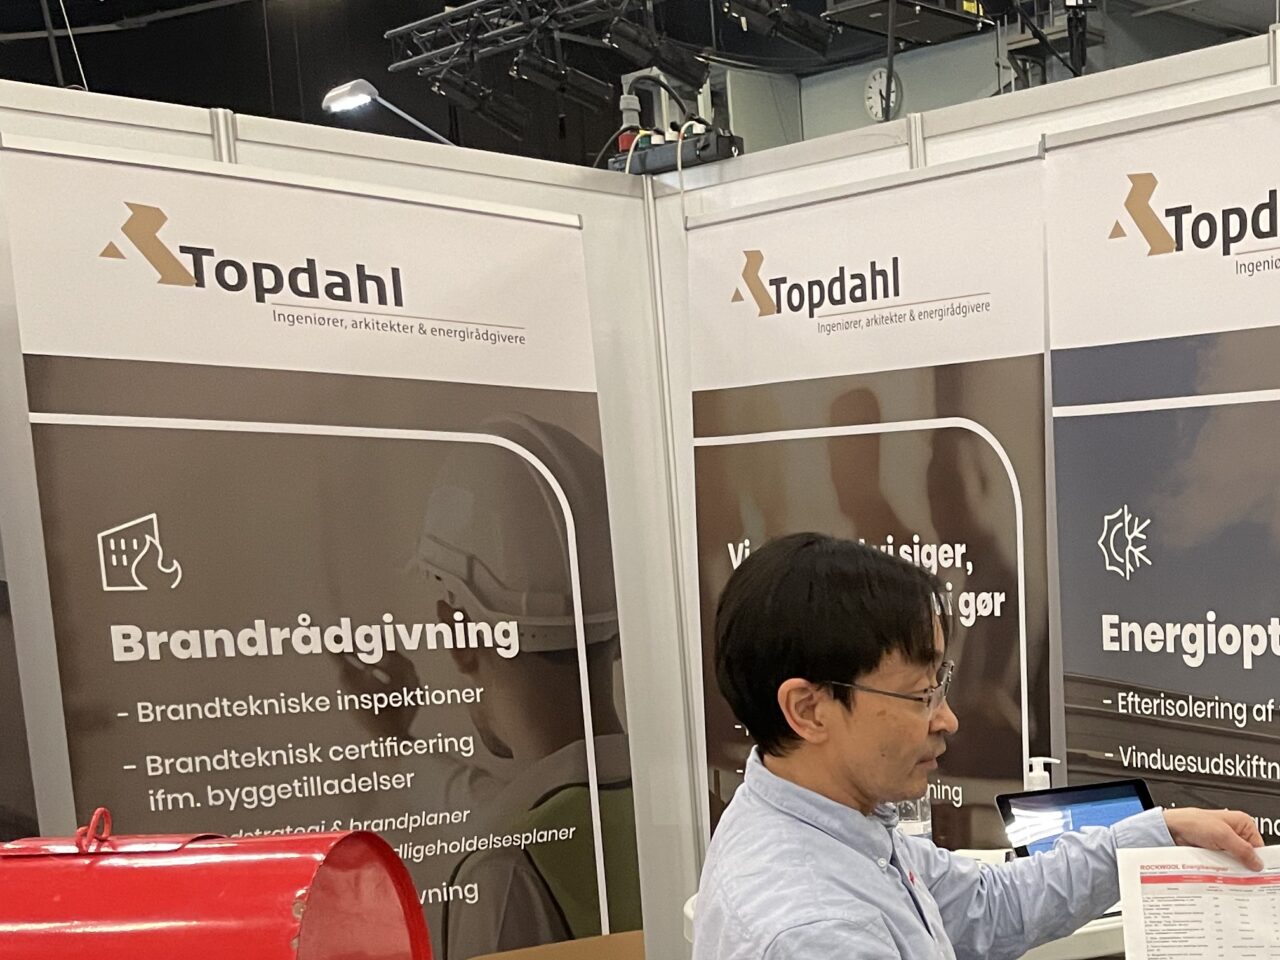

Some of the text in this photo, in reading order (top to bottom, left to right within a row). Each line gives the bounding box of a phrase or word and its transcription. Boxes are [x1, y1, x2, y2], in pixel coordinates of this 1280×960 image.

[179, 245, 404, 308] Topdahl
[769, 257, 900, 318] Topdahl
[272, 309, 526, 345] Ingeniører, arkitekter & energirådgivere
[817, 318, 862, 335] Ingeniører,
[865, 311, 907, 328] arkitekter
[918, 300, 991, 321] energirådgivere
[899, 535, 973, 575] siger,
[958, 591, 1005, 627] gør
[110, 612, 519, 664] Brandrådgivning
[137, 692, 331, 723] Brandtekniske
[336, 685, 484, 714] inspektioner
[1117, 691, 1247, 728] Efterisolering
[1252, 698, 1275, 722] af
[146, 743, 323, 776] Brandteknisk
[328, 733, 474, 763] certificering
[148, 770, 415, 811] ifm. byggetilladelser
[350, 807, 470, 834] brandplaner
[393, 824, 576, 863] dligeholdelsesplaner
